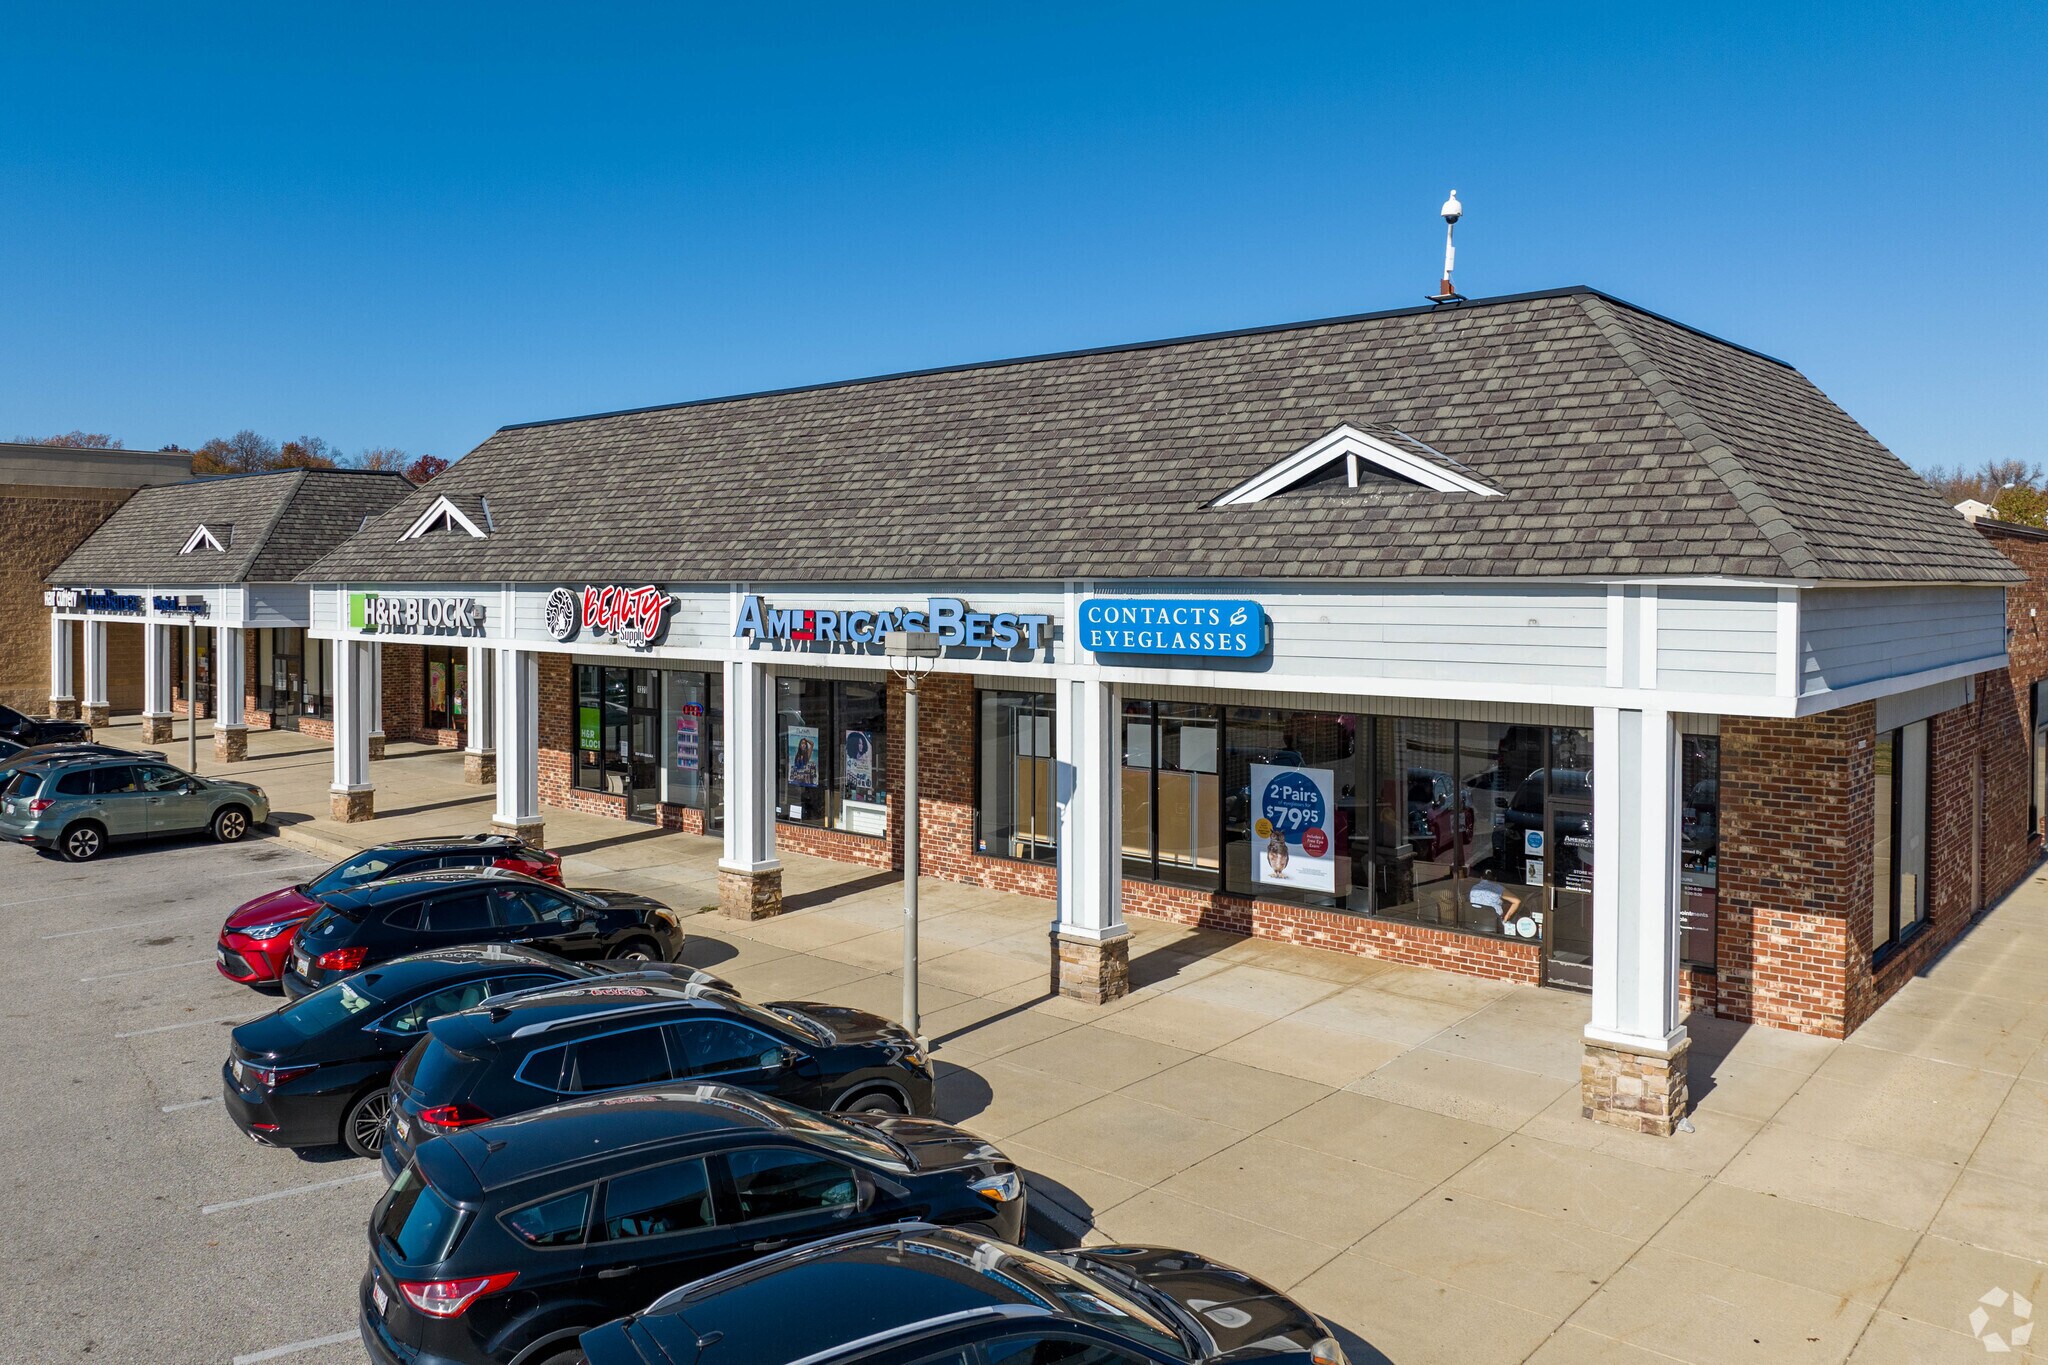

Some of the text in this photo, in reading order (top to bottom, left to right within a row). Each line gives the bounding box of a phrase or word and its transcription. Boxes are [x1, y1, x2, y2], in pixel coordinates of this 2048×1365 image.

[364, 598, 473, 628] H&R BLOCK
[928, 597, 1049, 649] BEST
[1088, 606, 1248, 628] CONTACTS &
[619, 626, 645, 645] Supply
[1090, 630, 1248, 651] EYEGLASSES
[581, 729, 595, 739] H&R
[1270, 785, 1318, 803] 2 Pairs
